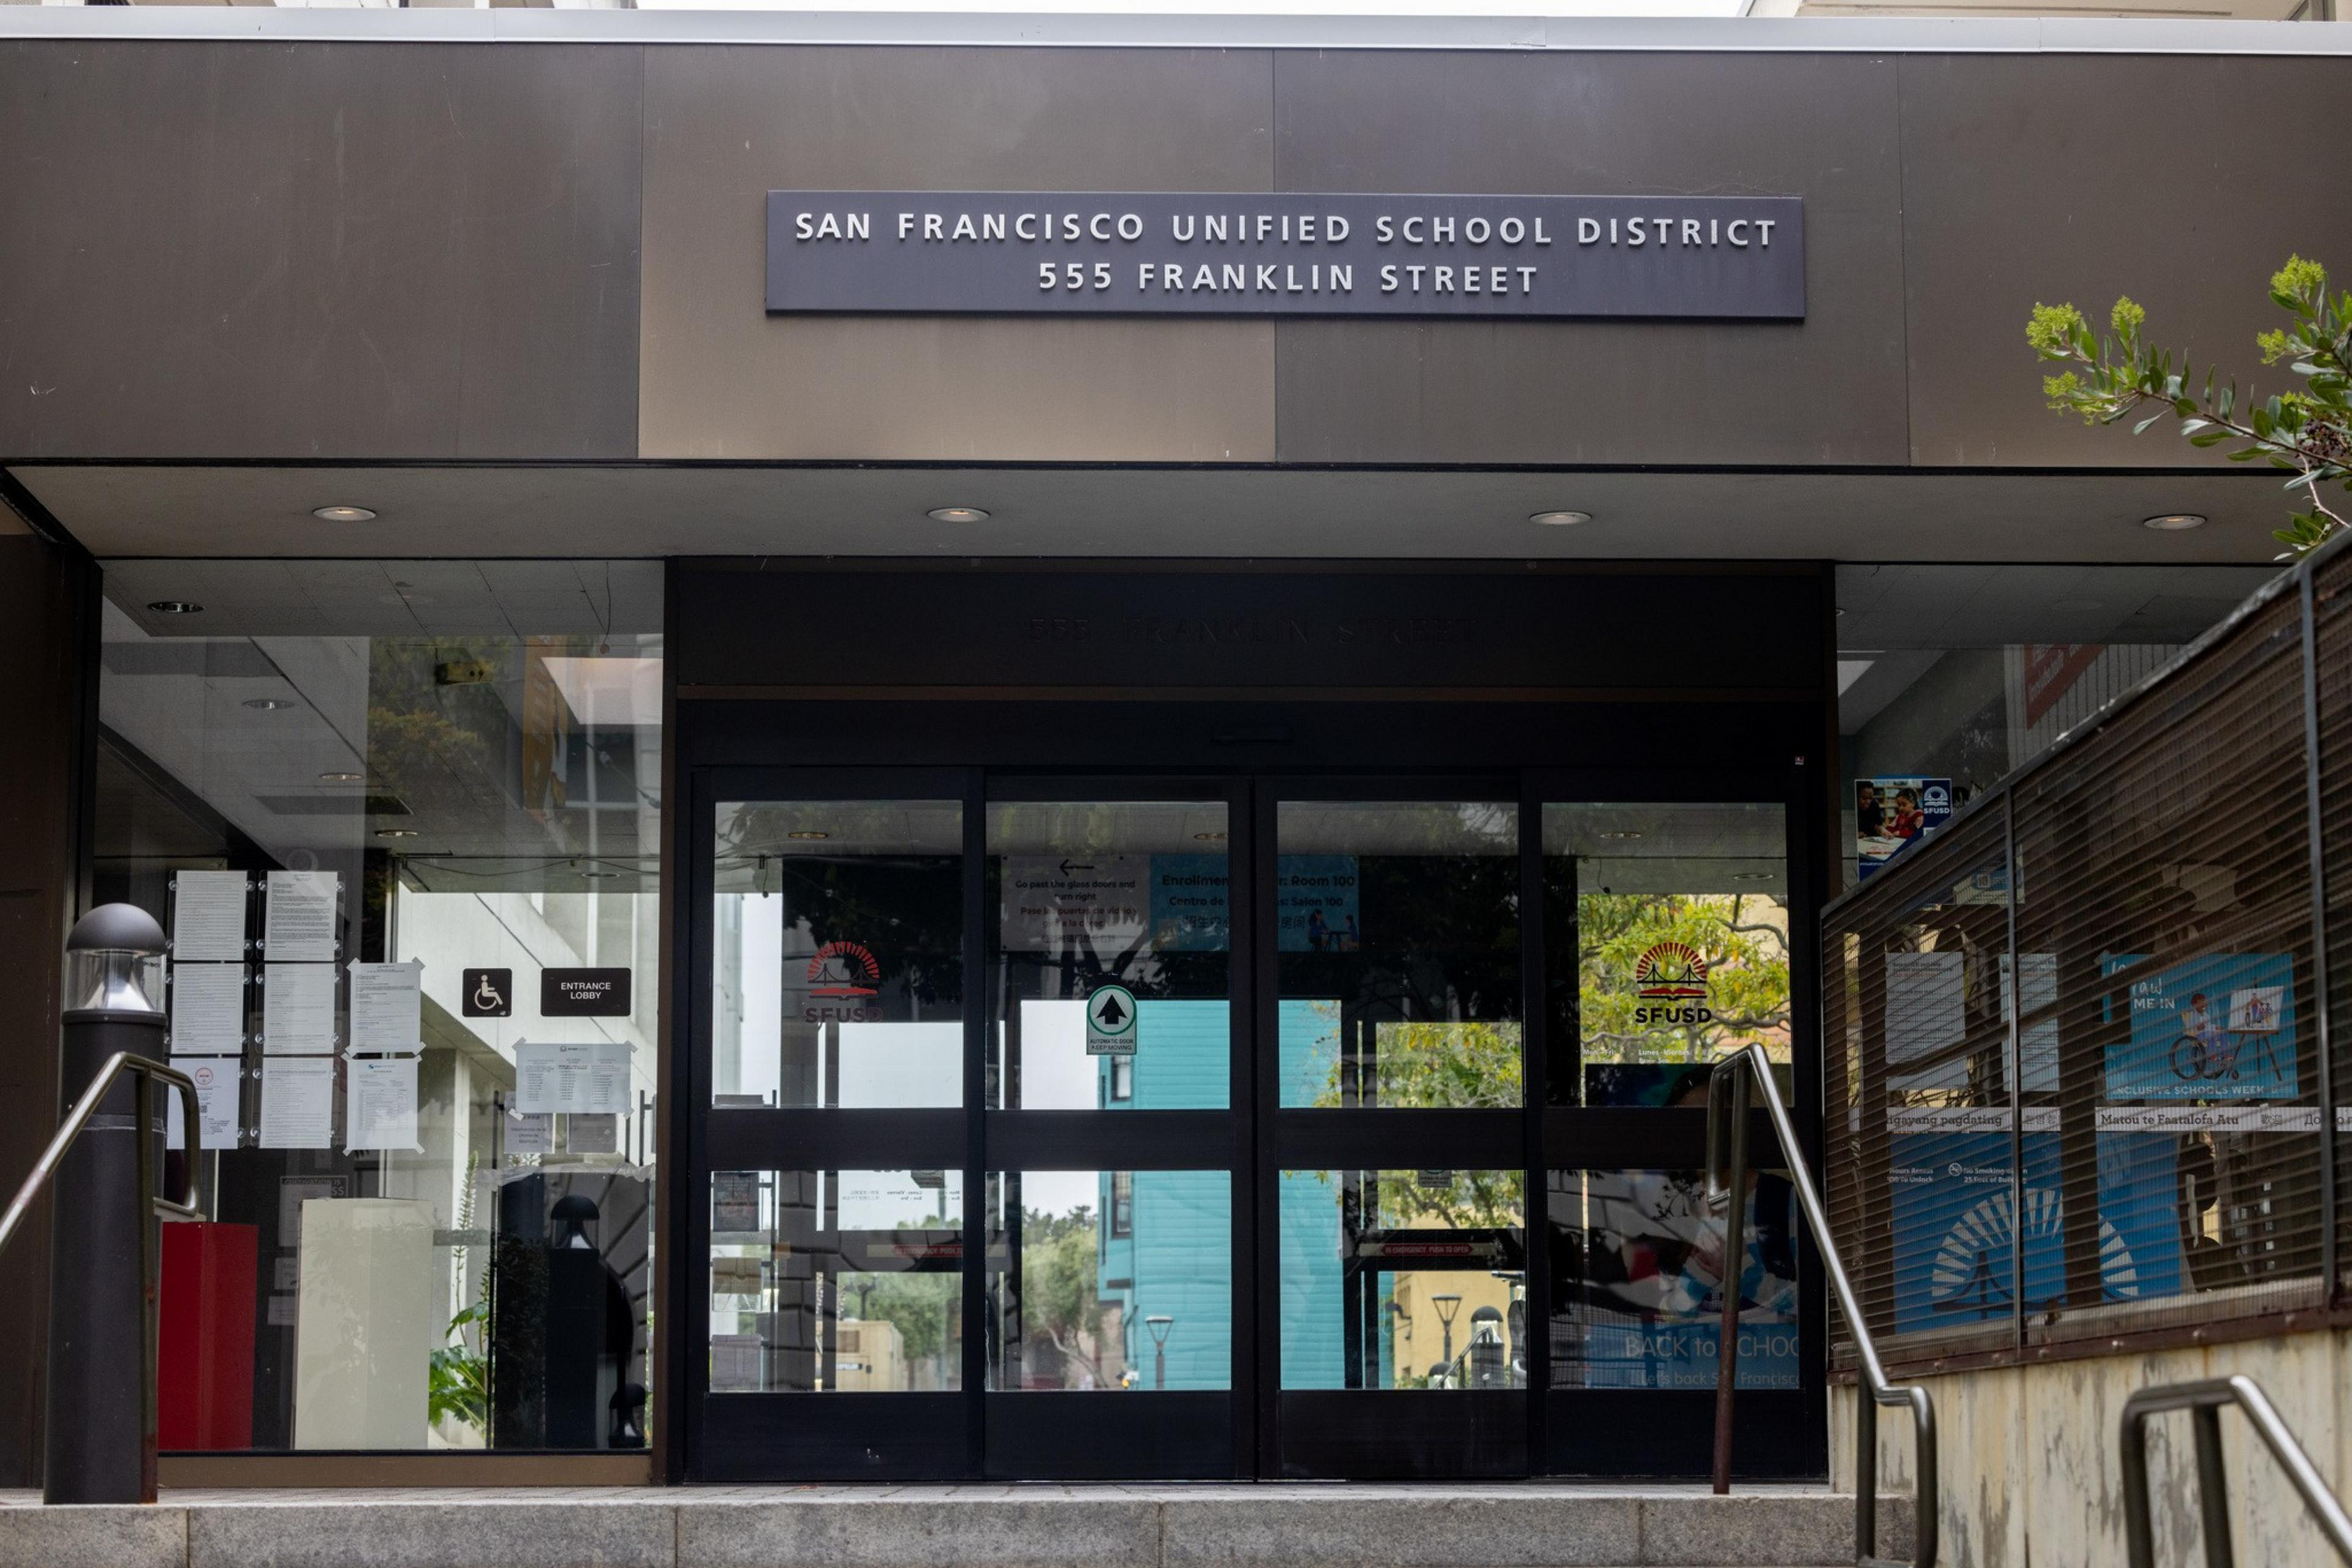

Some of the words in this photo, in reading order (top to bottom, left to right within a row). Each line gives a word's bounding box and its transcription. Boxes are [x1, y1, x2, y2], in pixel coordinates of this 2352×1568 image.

[796, 213, 869, 239] SAN
[898, 214, 1143, 241] FRANCISCO
[1173, 216, 1350, 242] UNIFIED
[1376, 216, 1552, 244] SCHOOL
[1578, 217, 1775, 246] DISTRICT
[1040, 263, 1112, 289] 555
[1138, 263, 1354, 292] FRANKLIN
[1382, 265, 1537, 293] STREET
[1122, 617, 1309, 643] FRANKLIN
[1338, 617, 1479, 643] STREET
[1068, 881, 1090, 889] glass
[1162, 875, 1230, 886] Enrollmen
[1291, 876, 1329, 886] Room
[1333, 876, 1355, 886] 100
[1075, 892, 1096, 902] right
[1170, 896, 1206, 907] Centro
[1210, 896, 1224, 907] de
[1325, 897, 1344, 907] 100
[561, 982, 611, 990] ENTRANCE
[2134, 998, 2155, 1009] ME
[2160, 998, 2175, 1009] IN
[805, 1008, 883, 1023] SFUSD
[1635, 1008, 1712, 1023] SFUSD
[2112, 1086, 2171, 1095] INCLUSIVE
[2174, 1086, 2228, 1095] SCHOOLS
[2231, 1086, 2264, 1095] WEEK
[1940, 1114, 2002, 1128] pagdating
[2101, 1115, 2139, 1125] Matou
[2142, 1115, 2155, 1125] te
[2158, 1114, 2213, 1125] Faatalofa
[2217, 1115, 2239, 1125] Atu
[1626, 1336, 1688, 1357] BACK
[1695, 1338, 1716, 1357] to
[1738, 1336, 1799, 1357] CHO
[1674, 1372, 1706, 1385] back
